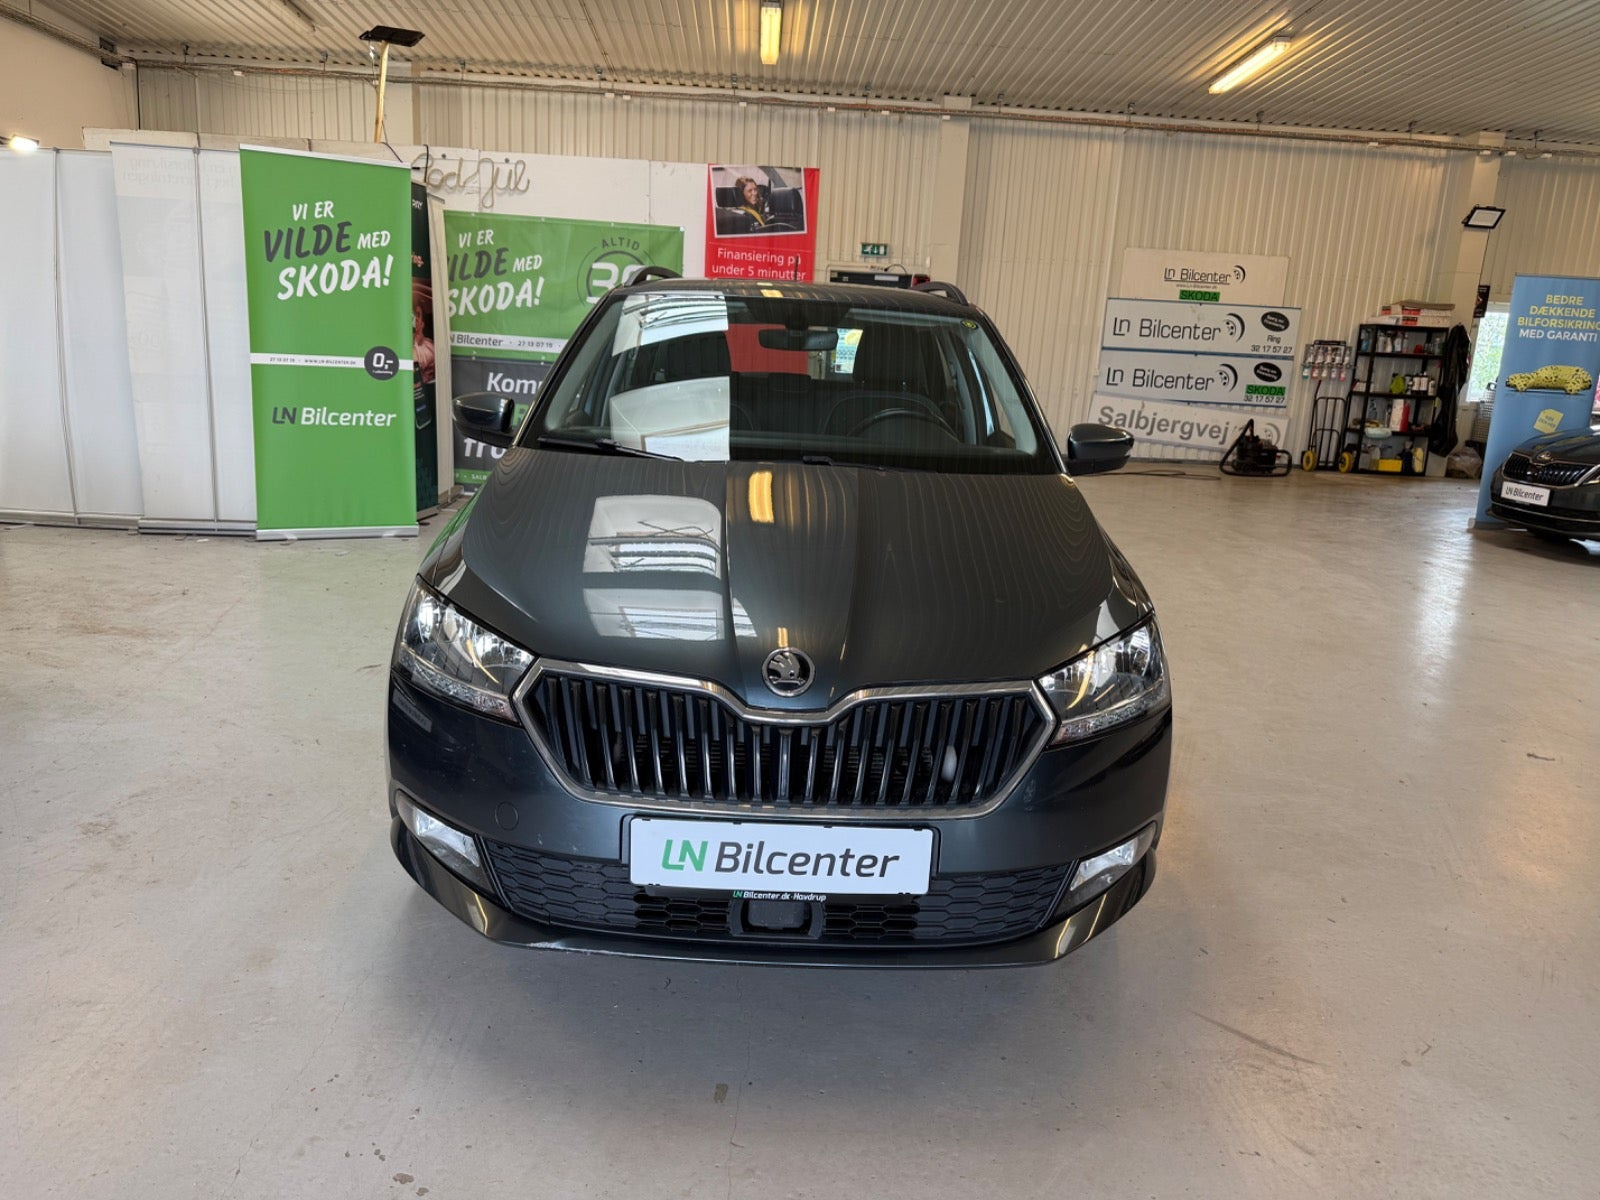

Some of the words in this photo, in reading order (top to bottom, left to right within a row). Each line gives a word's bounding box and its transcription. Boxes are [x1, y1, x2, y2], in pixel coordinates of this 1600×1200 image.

[292, 204, 308, 221] VI
[314, 200, 335, 219] ER
[264, 221, 352, 263] VILDE
[357, 230, 391, 250] MED
[458, 232, 471, 248] VI
[477, 229, 495, 246] ER
[602, 236, 640, 251] ALTID
[447, 247, 509, 282] ILDE
[512, 254, 543, 273] MED
[717, 248, 784, 267] Finansiering
[277, 254, 394, 300] SKODA!
[712, 264, 745, 276] under
[747, 266, 754, 276] 5
[757, 268, 806, 280] minutter
[1180, 268, 1232, 283] Bilcenter
[448, 277, 544, 318] SKODA!
[1180, 290, 1220, 302] SKODA
[1545, 294, 1584, 305] BEDRE
[1529, 305, 1597, 318] DÆKKENDE
[1138, 317, 1221, 341] Bilcenter
[1519, 328, 1545, 339] MED
[1546, 330, 1598, 342] GARANTI
[456, 334, 504, 347] Bilcenter
[1267, 335, 1281, 344] Ring
[486, 372, 545, 394] Kom
[1132, 368, 1215, 391] Bilcenter
[1246, 385, 1285, 395] SKODA
[272, 407, 297, 425] LN
[301, 406, 397, 427] Bilcenter
[1098, 406, 1231, 446] Salbjergvej
[1513, 487, 1545, 501] Bilcenter
[661, 839, 709, 872] LN
[714, 840, 900, 878] Bilcenter
